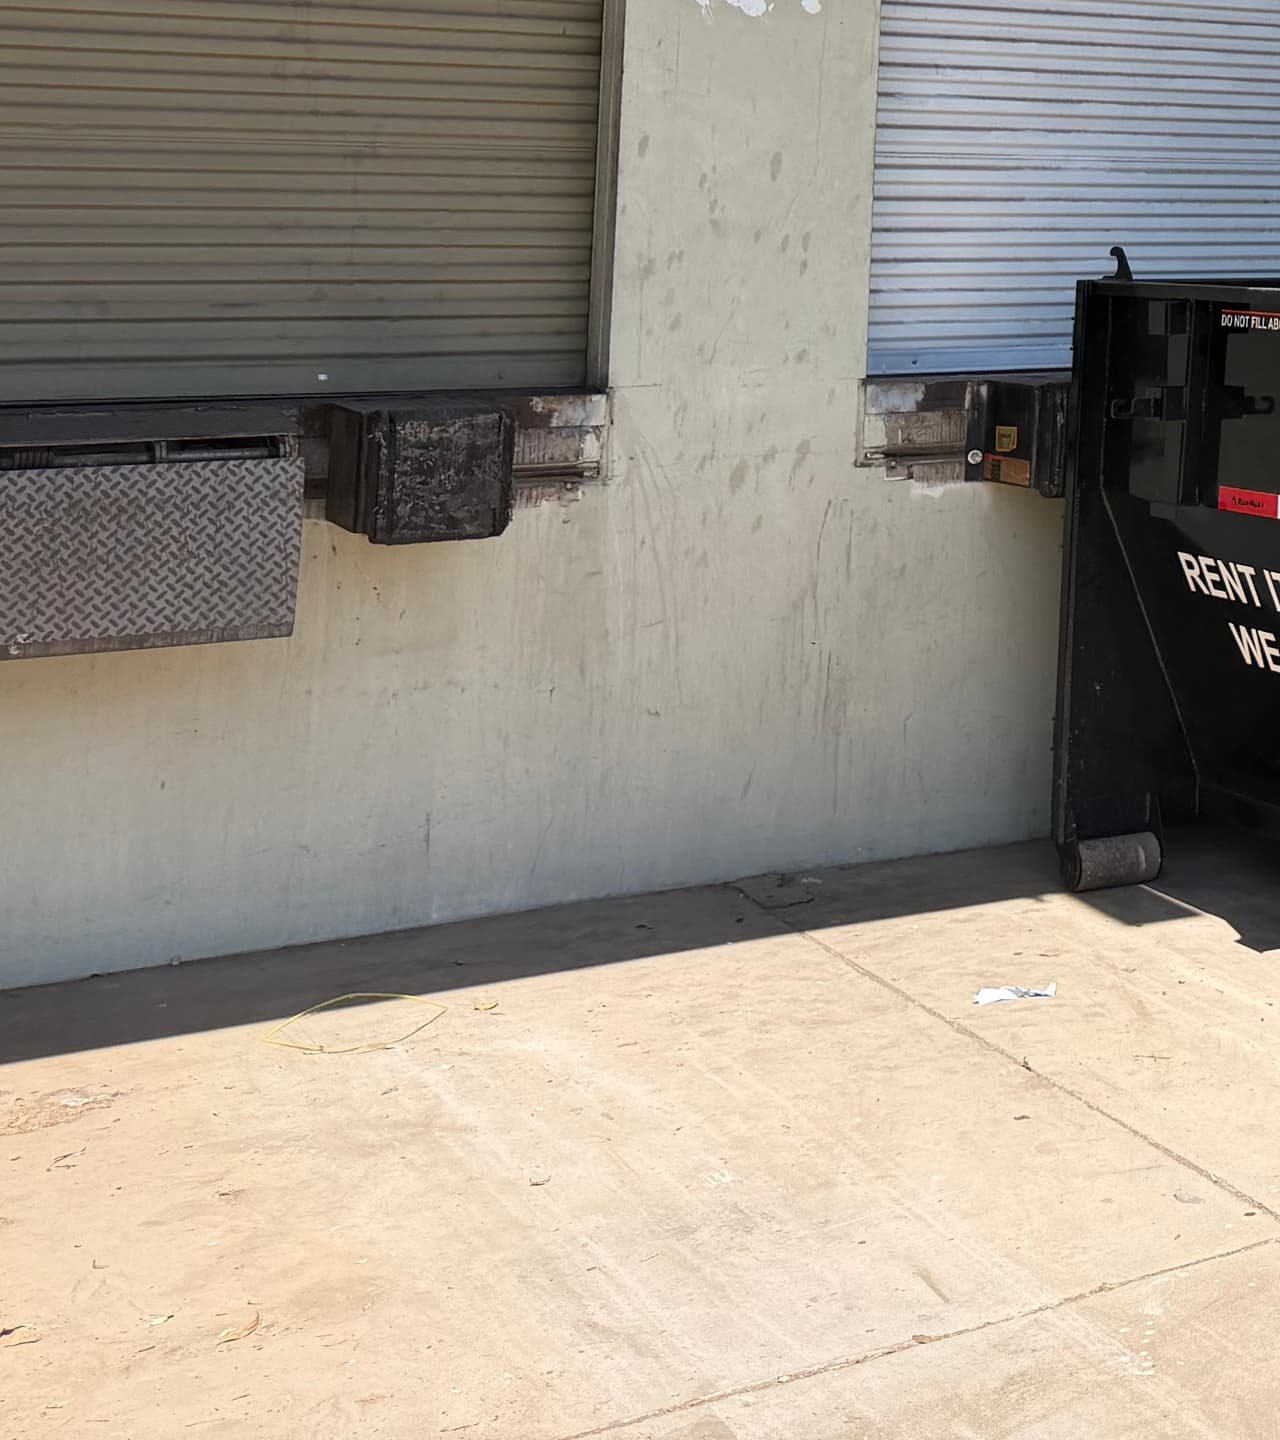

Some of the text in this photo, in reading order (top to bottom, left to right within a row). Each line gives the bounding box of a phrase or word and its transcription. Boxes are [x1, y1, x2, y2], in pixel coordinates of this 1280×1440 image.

[1221, 313, 1233, 327] DO
[1233, 315, 1250, 329] NOT
[1250, 316, 1268, 330] FILL
[1177, 551, 1262, 608] RENT
